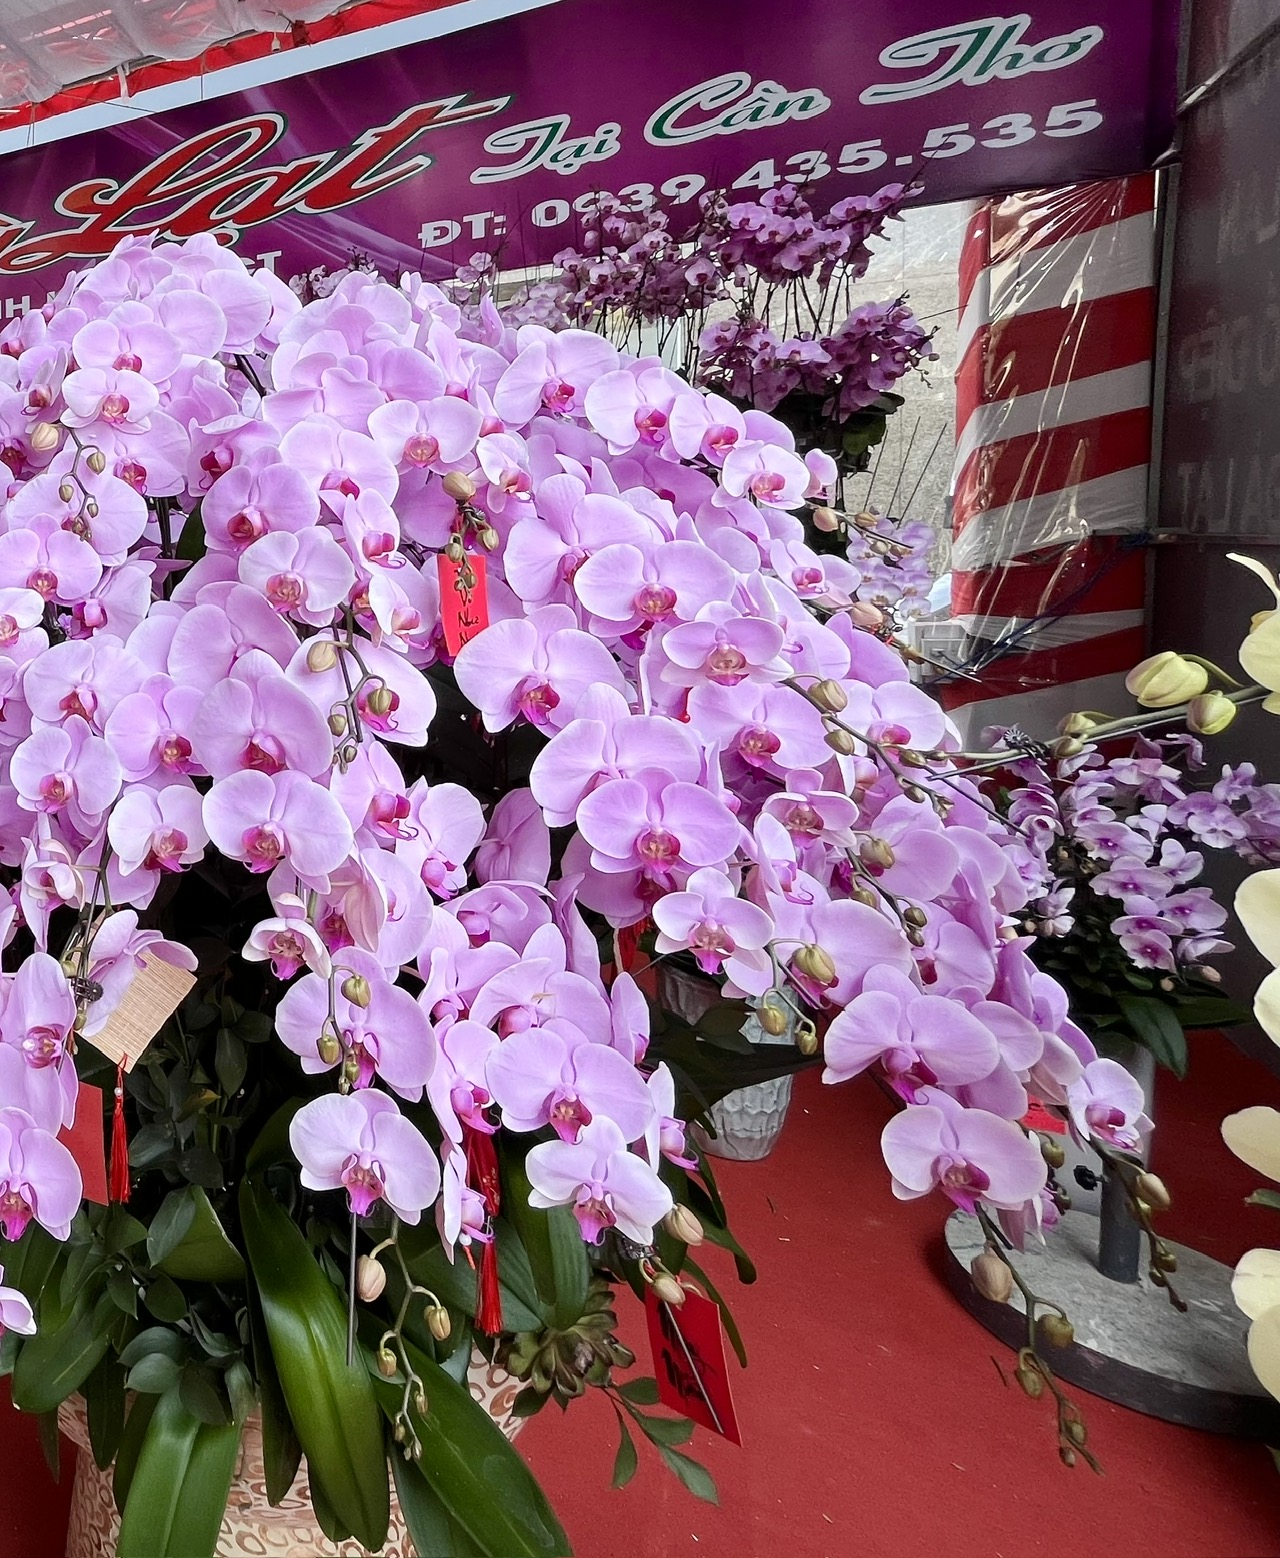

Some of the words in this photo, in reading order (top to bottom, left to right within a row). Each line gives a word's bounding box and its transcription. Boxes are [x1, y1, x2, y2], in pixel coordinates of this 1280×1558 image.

[470, 113, 621, 185] Tại
[645, 72, 831, 147] Cần
[859, 13, 1104, 105] Thơ
[417, 210, 506, 248] ĐT:
